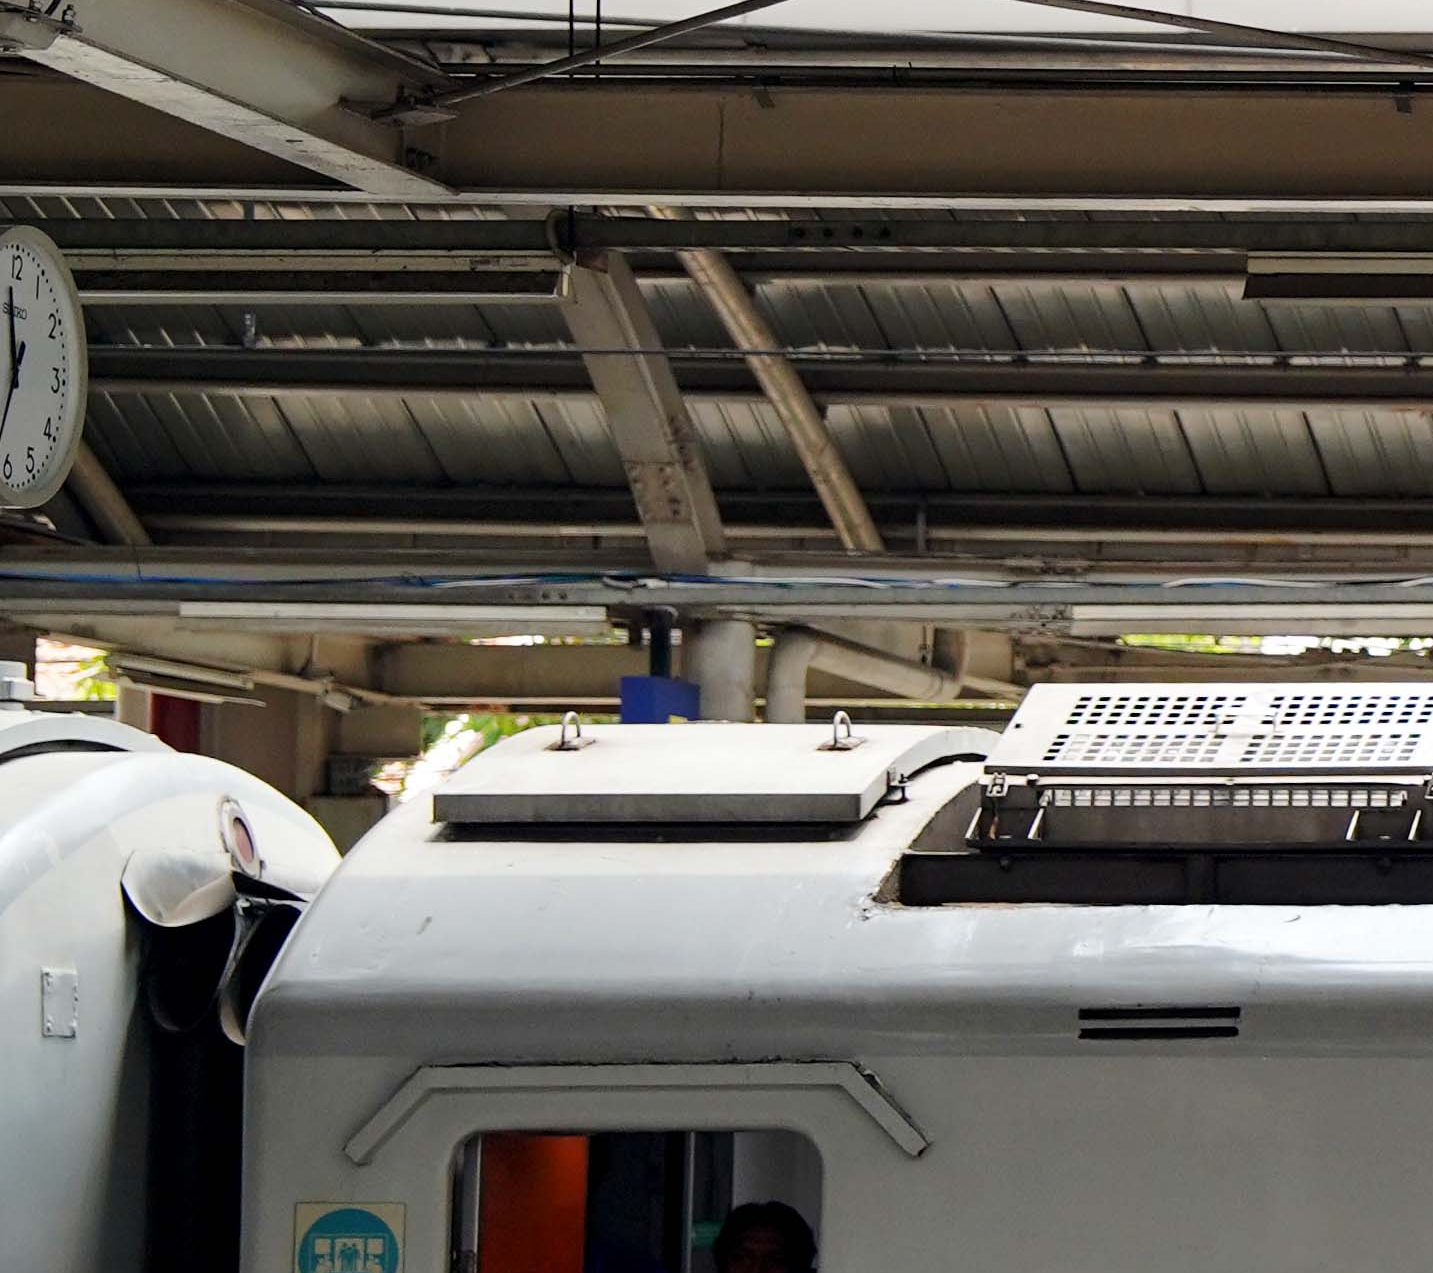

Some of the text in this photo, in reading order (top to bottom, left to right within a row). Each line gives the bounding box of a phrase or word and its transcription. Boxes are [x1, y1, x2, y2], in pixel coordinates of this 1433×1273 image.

[11, 254, 23, 280] 12
[2, 302, 27, 320] SIKO
[48, 313, 57, 339] 2
[51, 367, 60, 394] 3
[43, 417, 52, 441] 4
[3, 453, 12, 480] 6
[25, 446, 35, 473] 5
